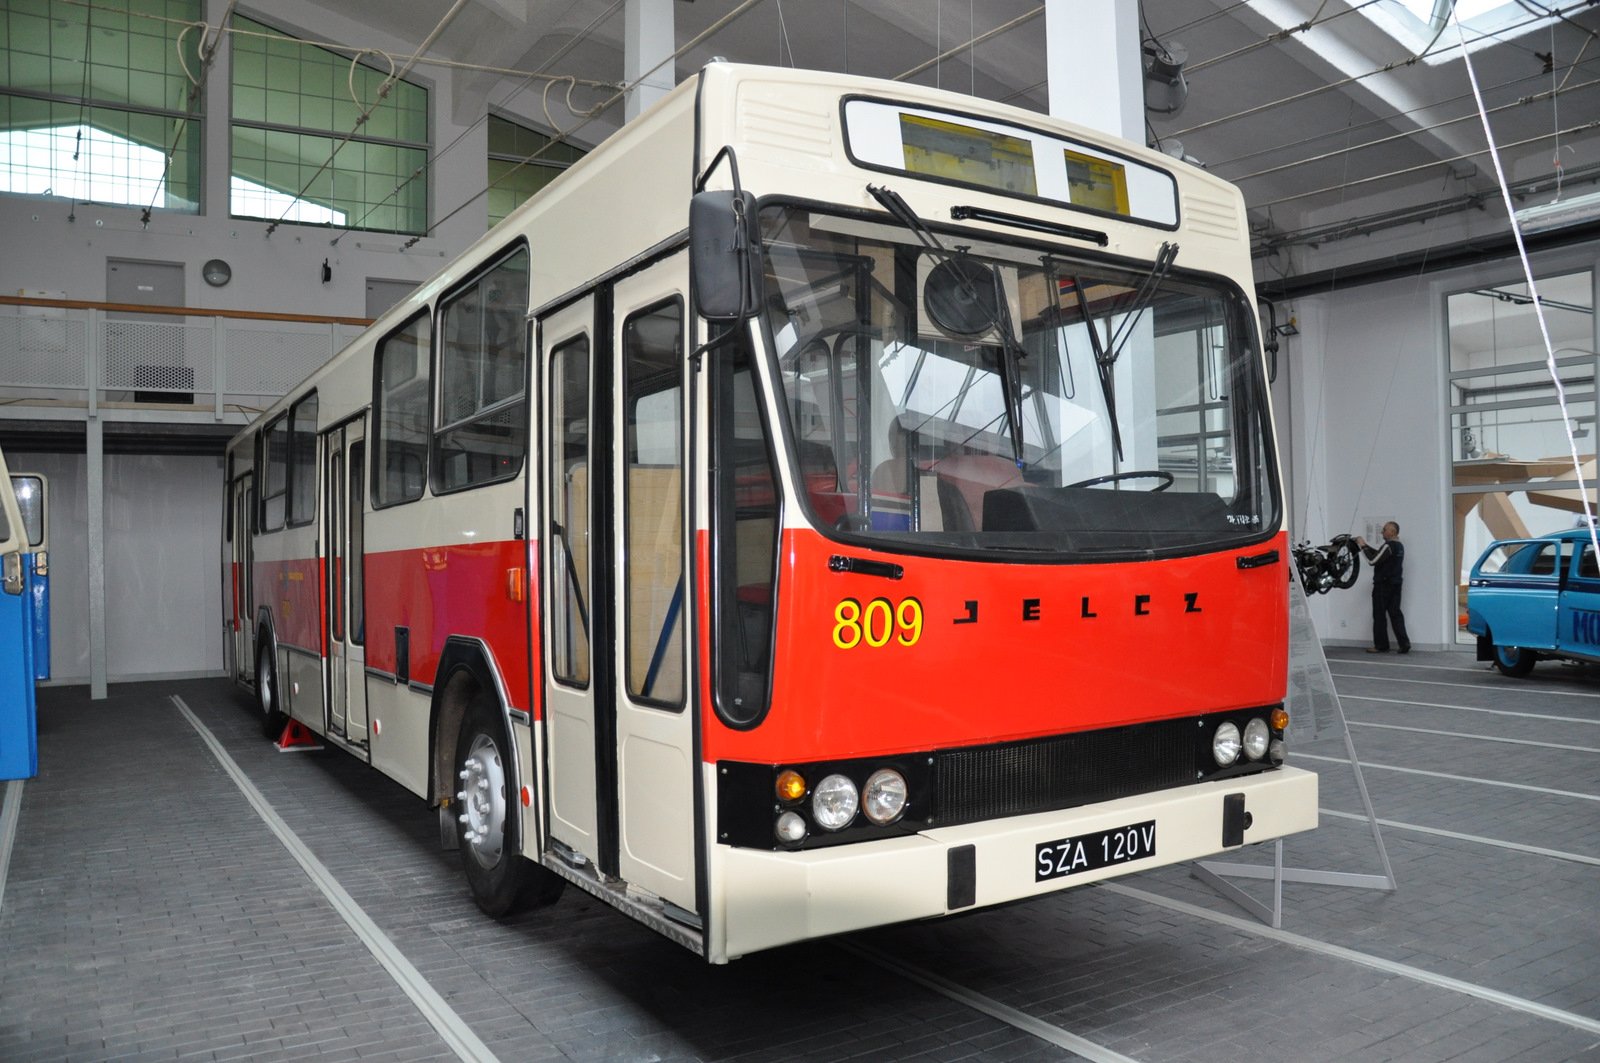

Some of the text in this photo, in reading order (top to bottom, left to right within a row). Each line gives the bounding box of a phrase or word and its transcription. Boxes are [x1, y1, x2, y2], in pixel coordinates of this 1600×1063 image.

[832, 596, 924, 649] 809
[953, 592, 1203, 625] JELCZ
[1101, 825, 1155, 862] 120V
